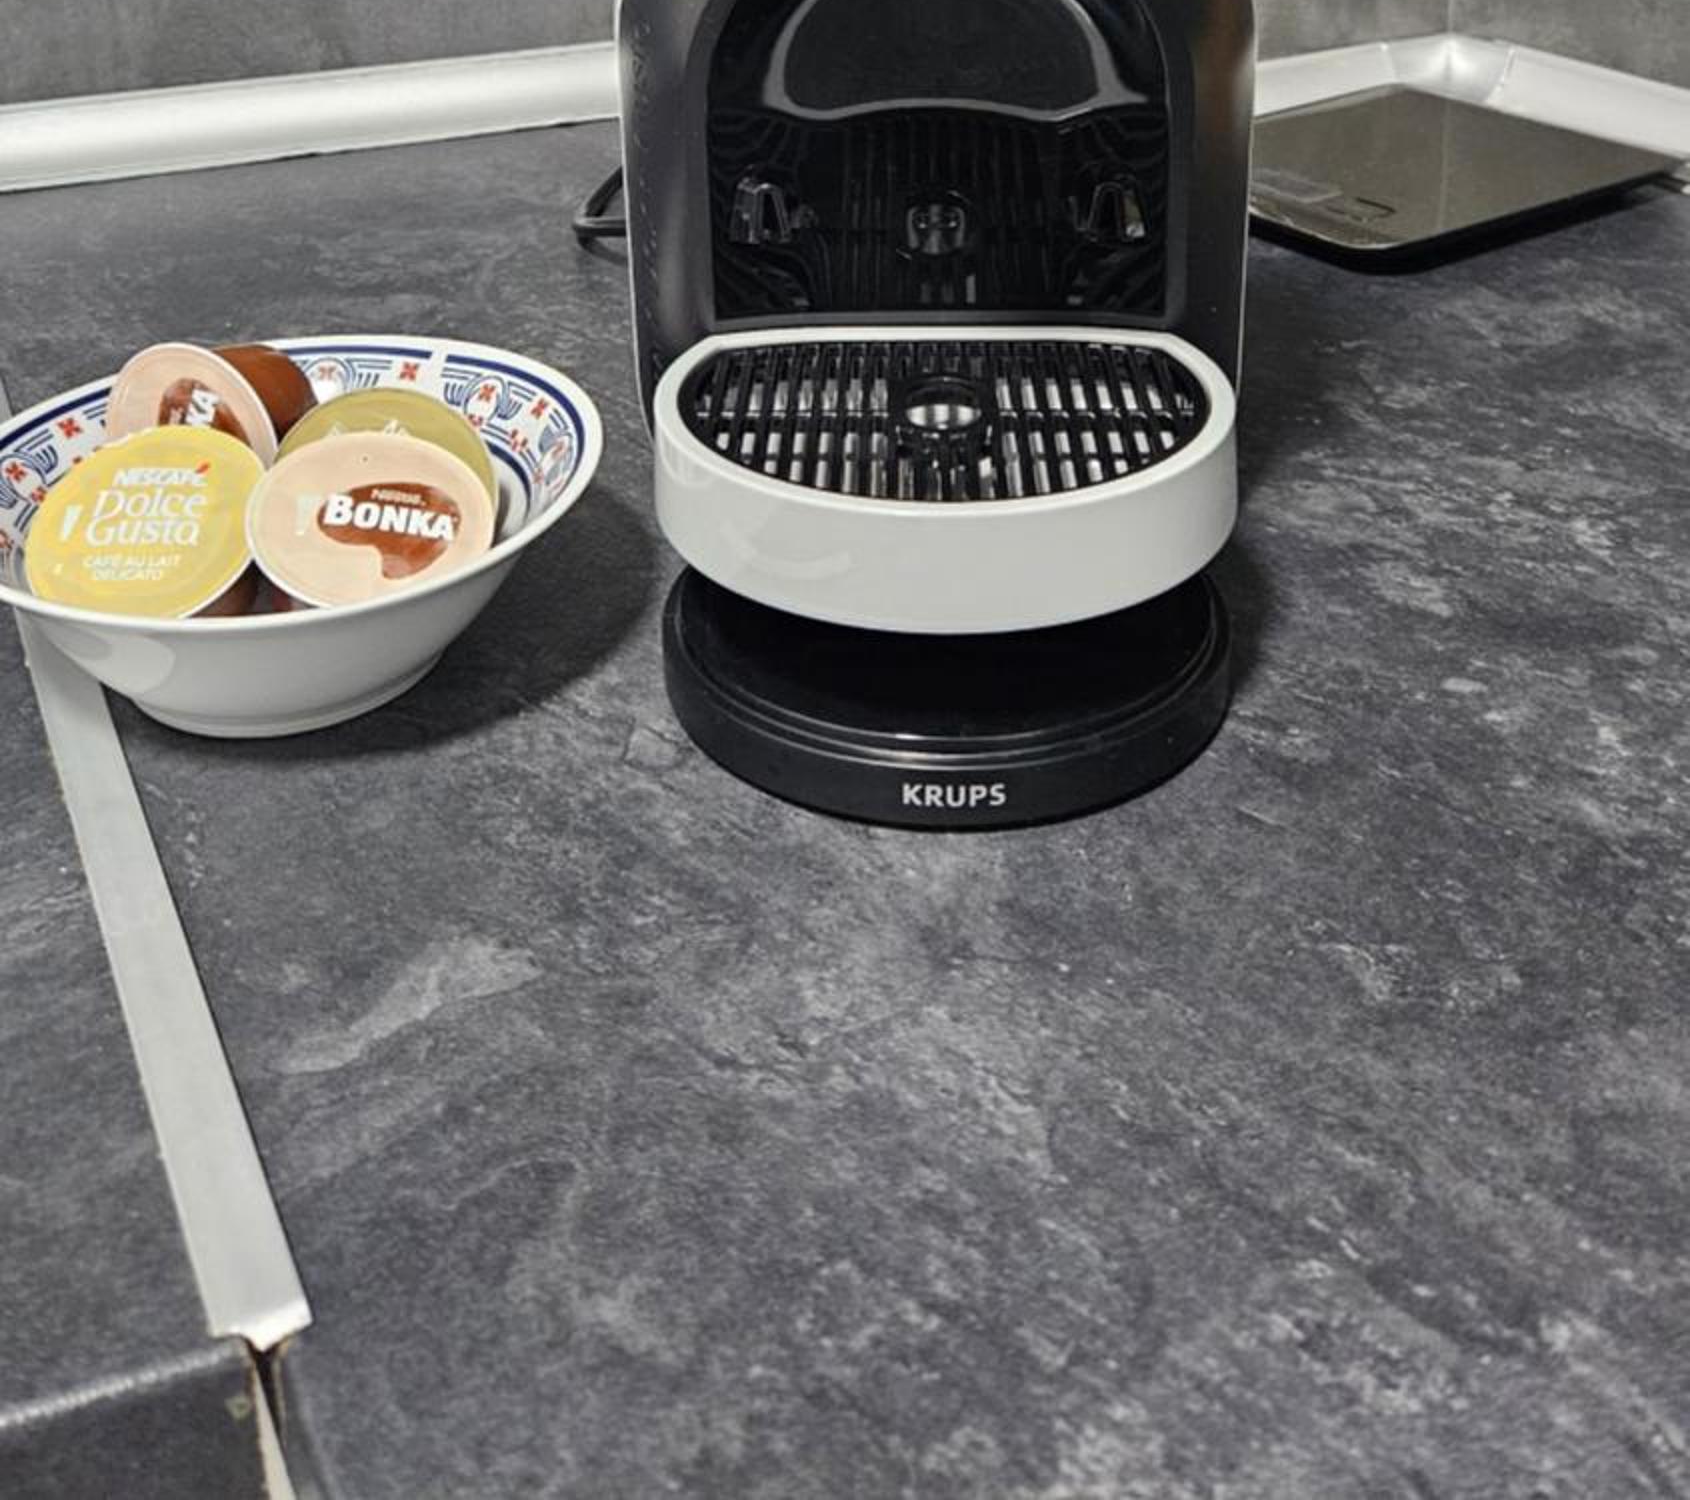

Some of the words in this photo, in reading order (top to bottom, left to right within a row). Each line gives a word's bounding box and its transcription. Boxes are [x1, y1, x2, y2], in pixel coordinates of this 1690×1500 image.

[94, 486, 207, 519] Dolce
[324, 494, 454, 540] BONKA
[903, 783, 1006, 808] KRUPS
